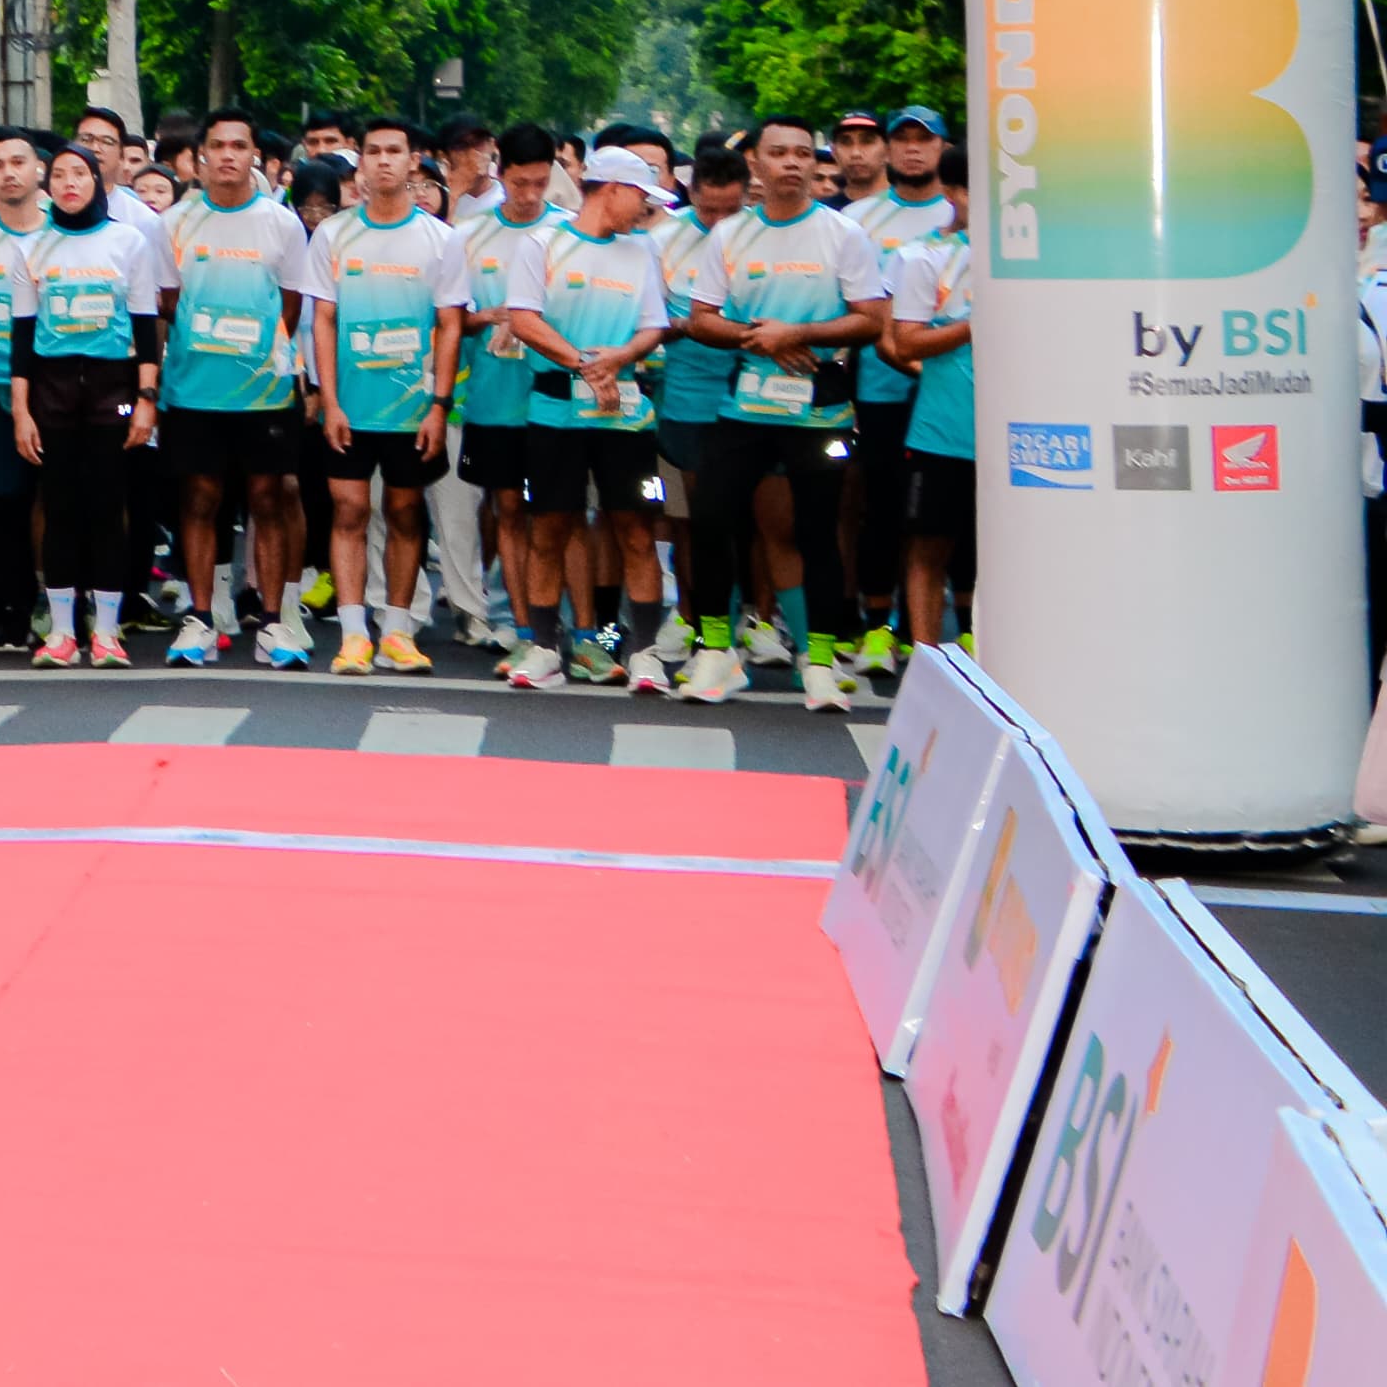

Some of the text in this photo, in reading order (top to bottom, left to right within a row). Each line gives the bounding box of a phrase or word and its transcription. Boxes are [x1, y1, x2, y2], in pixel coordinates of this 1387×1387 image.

[1132, 310, 1203, 366] by
[1128, 370, 1313, 397] #SemuaJadiMudah
[1010, 432, 1089, 451] POCARI
